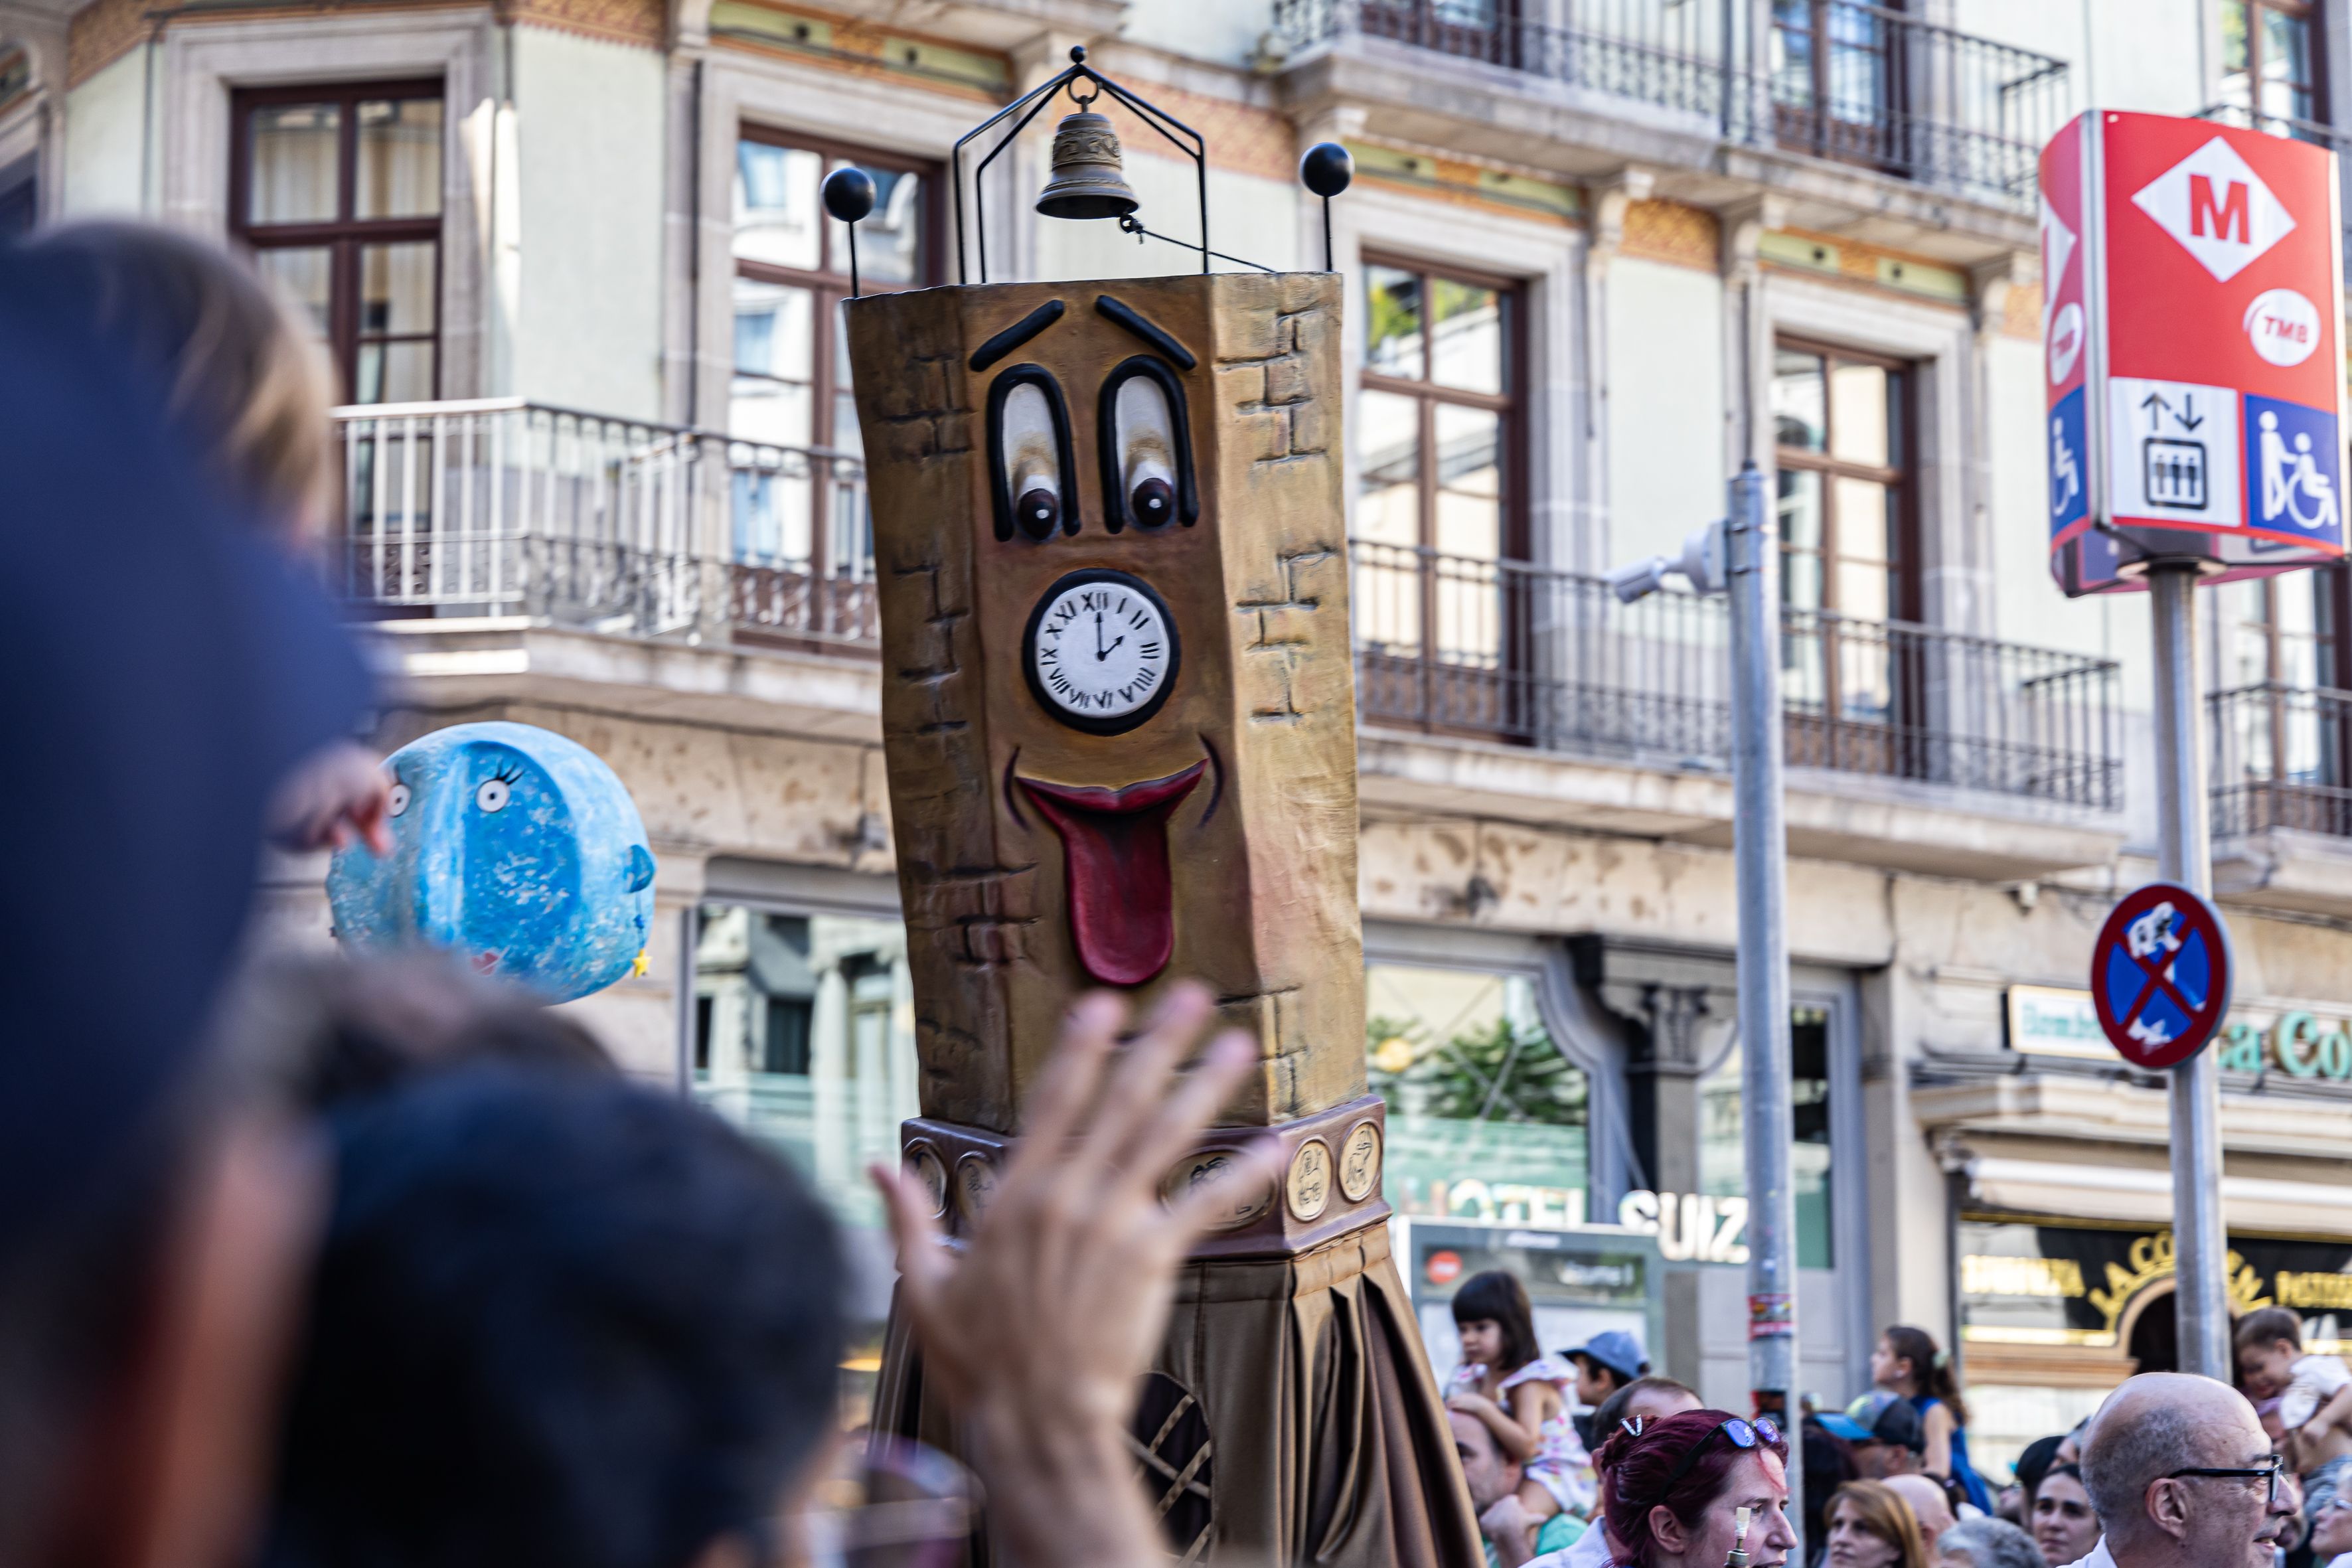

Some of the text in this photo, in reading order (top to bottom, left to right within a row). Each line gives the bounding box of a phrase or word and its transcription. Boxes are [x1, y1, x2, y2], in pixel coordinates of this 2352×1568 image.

[2189, 174, 2250, 246] M
[2262, 314, 2309, 345] TMB
[1055, 600, 1077, 625] XI
[1081, 591, 1109, 612] XII
[1045, 623, 1063, 640] X
[1129, 609, 1150, 631] II
[1140, 641, 1161, 660] III
[2276, 1010, 2352, 1079] Co
